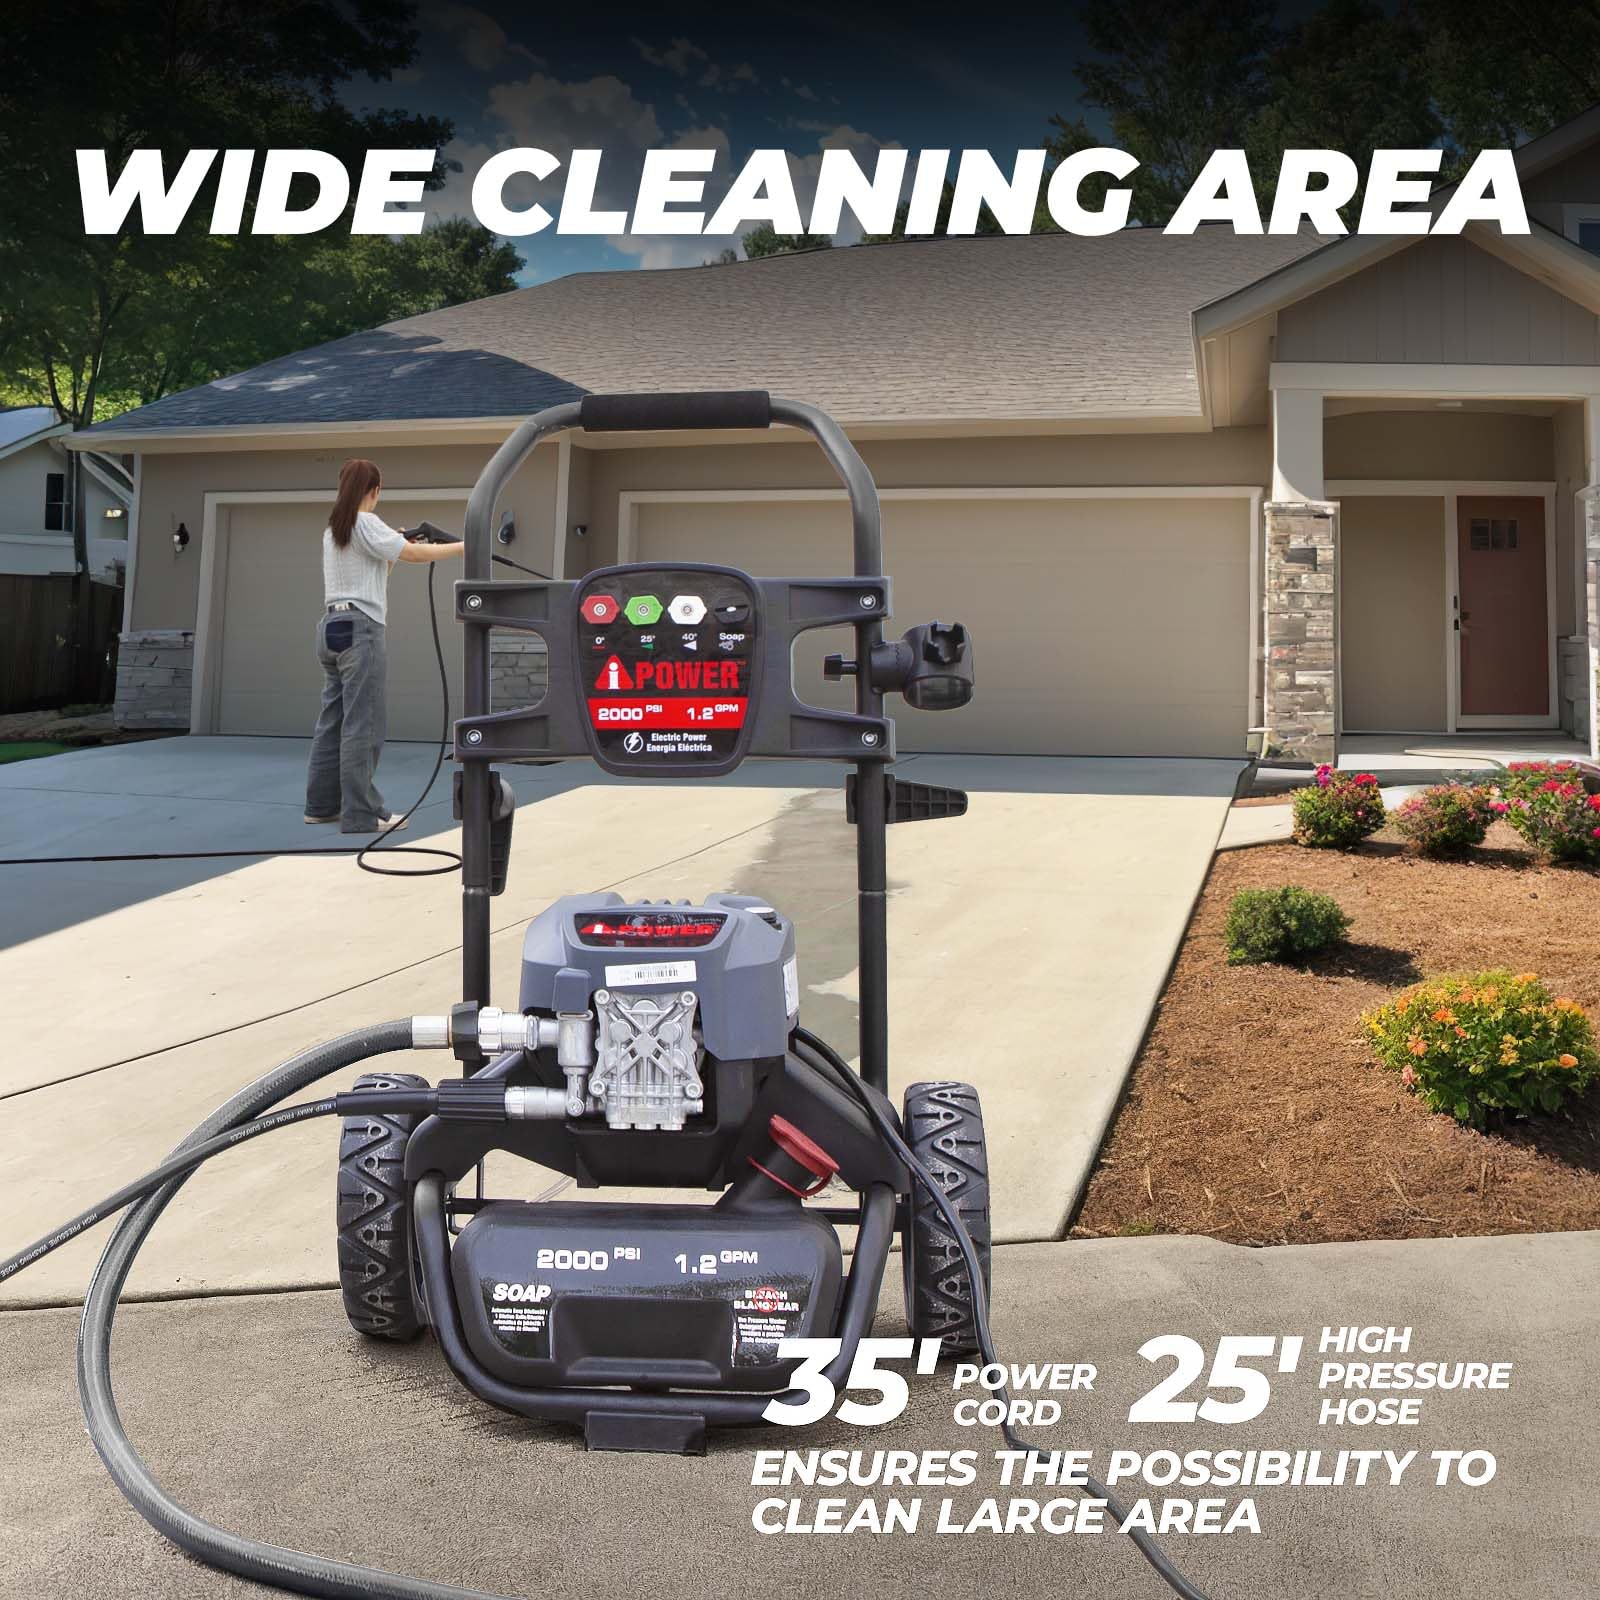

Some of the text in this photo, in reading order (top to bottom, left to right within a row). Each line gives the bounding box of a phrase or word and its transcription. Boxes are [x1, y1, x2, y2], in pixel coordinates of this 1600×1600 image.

[719, 632, 745, 641] Soap
[598, 704, 739, 721] 2000 PSI 1.2 GPM
[651, 732, 707, 741] Electric Power
[646, 743, 713, 753] Energía Eléctrica
[277, 1112, 295, 1123] FROM
[296, 1107, 314, 1116] AWAY
[262, 1118, 275, 1128] HOT
[82, 1212, 98, 1226] HIGH
[48, 1223, 81, 1248] PRESSURE
[536, 1247, 759, 1275] 2000 PSI 1.2 GPM
[0, 1262, 19, 1277] HOSE
[492, 1283, 551, 1302] SOAP
